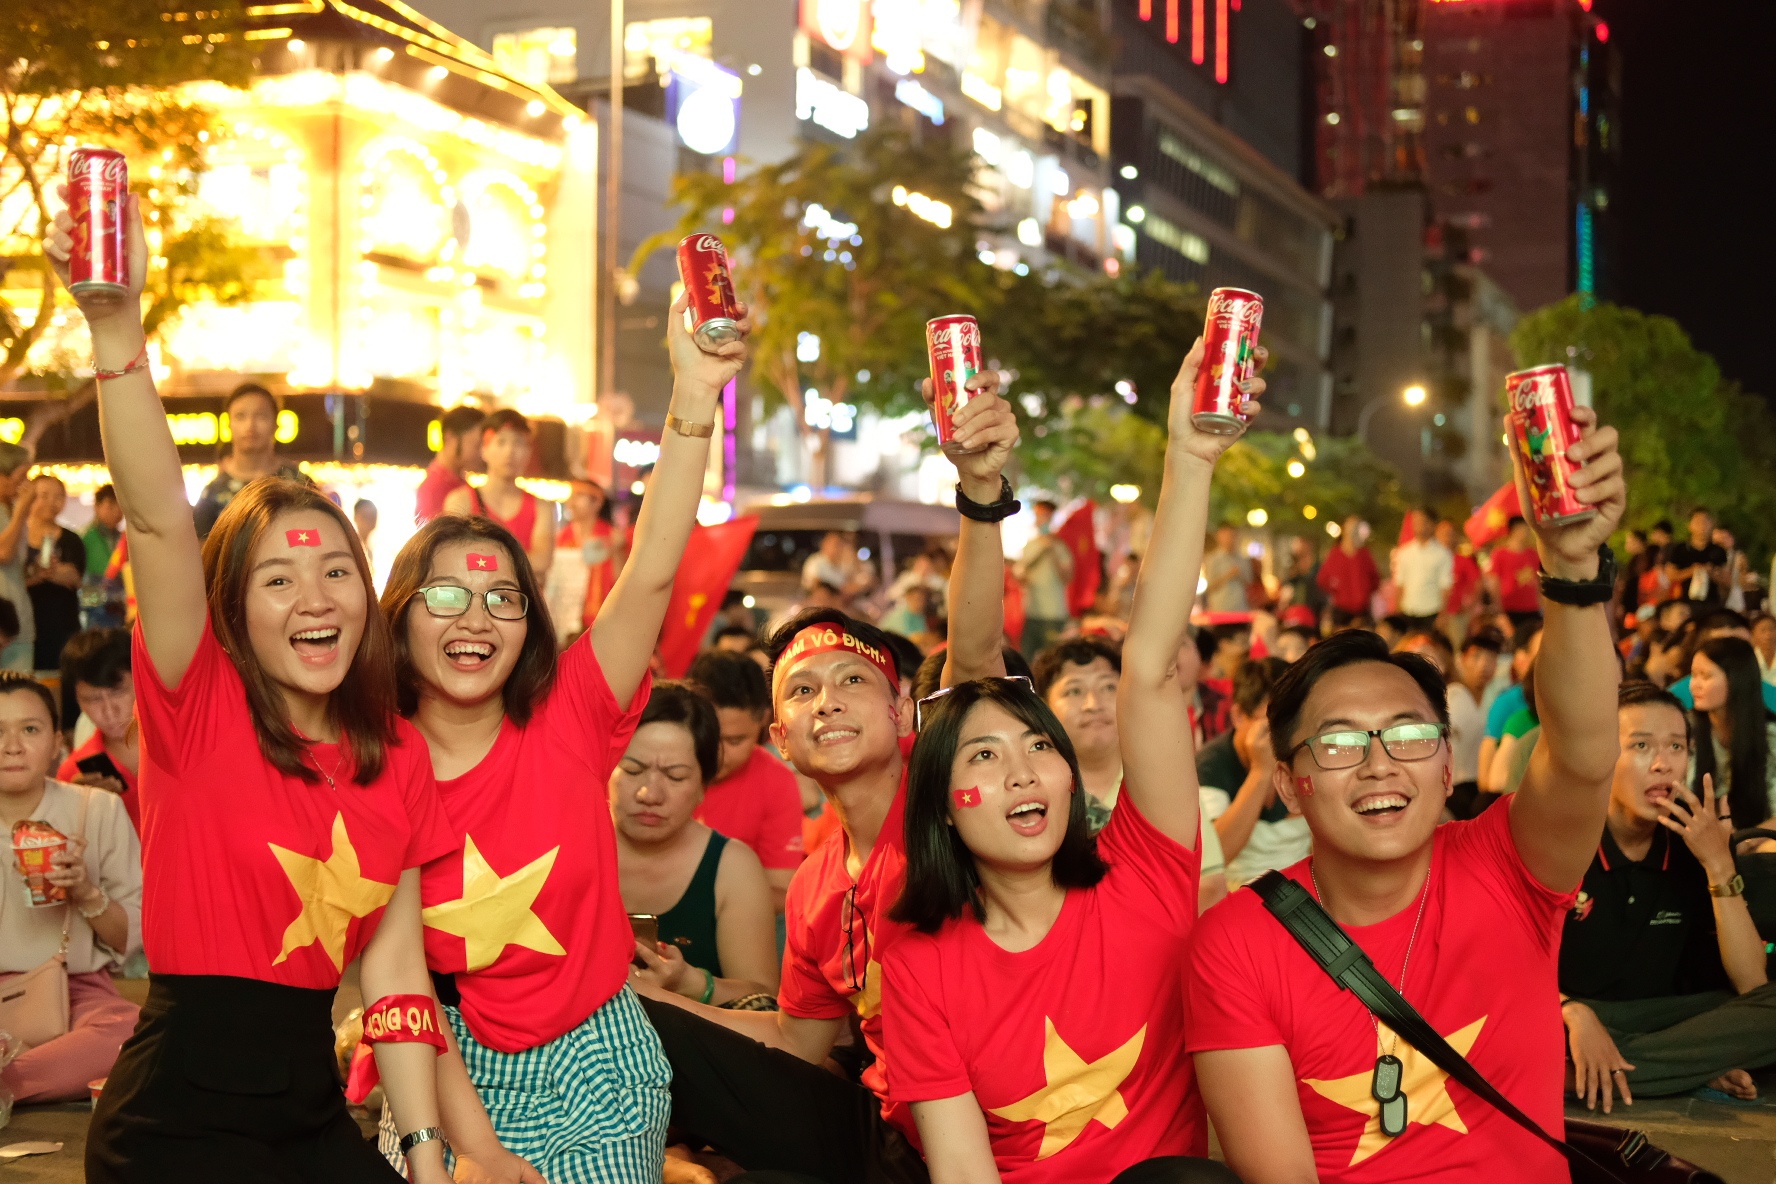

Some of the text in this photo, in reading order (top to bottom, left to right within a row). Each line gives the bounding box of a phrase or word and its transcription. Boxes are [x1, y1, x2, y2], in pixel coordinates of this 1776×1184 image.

[70, 154, 128, 184] Coca-Co
[1208, 293, 1263, 328] Coca-Col
[811, 628, 838, 648] VÔ
[842, 633, 880, 664] ĐỊCH
[406, 1006, 434, 1037] VÔ
